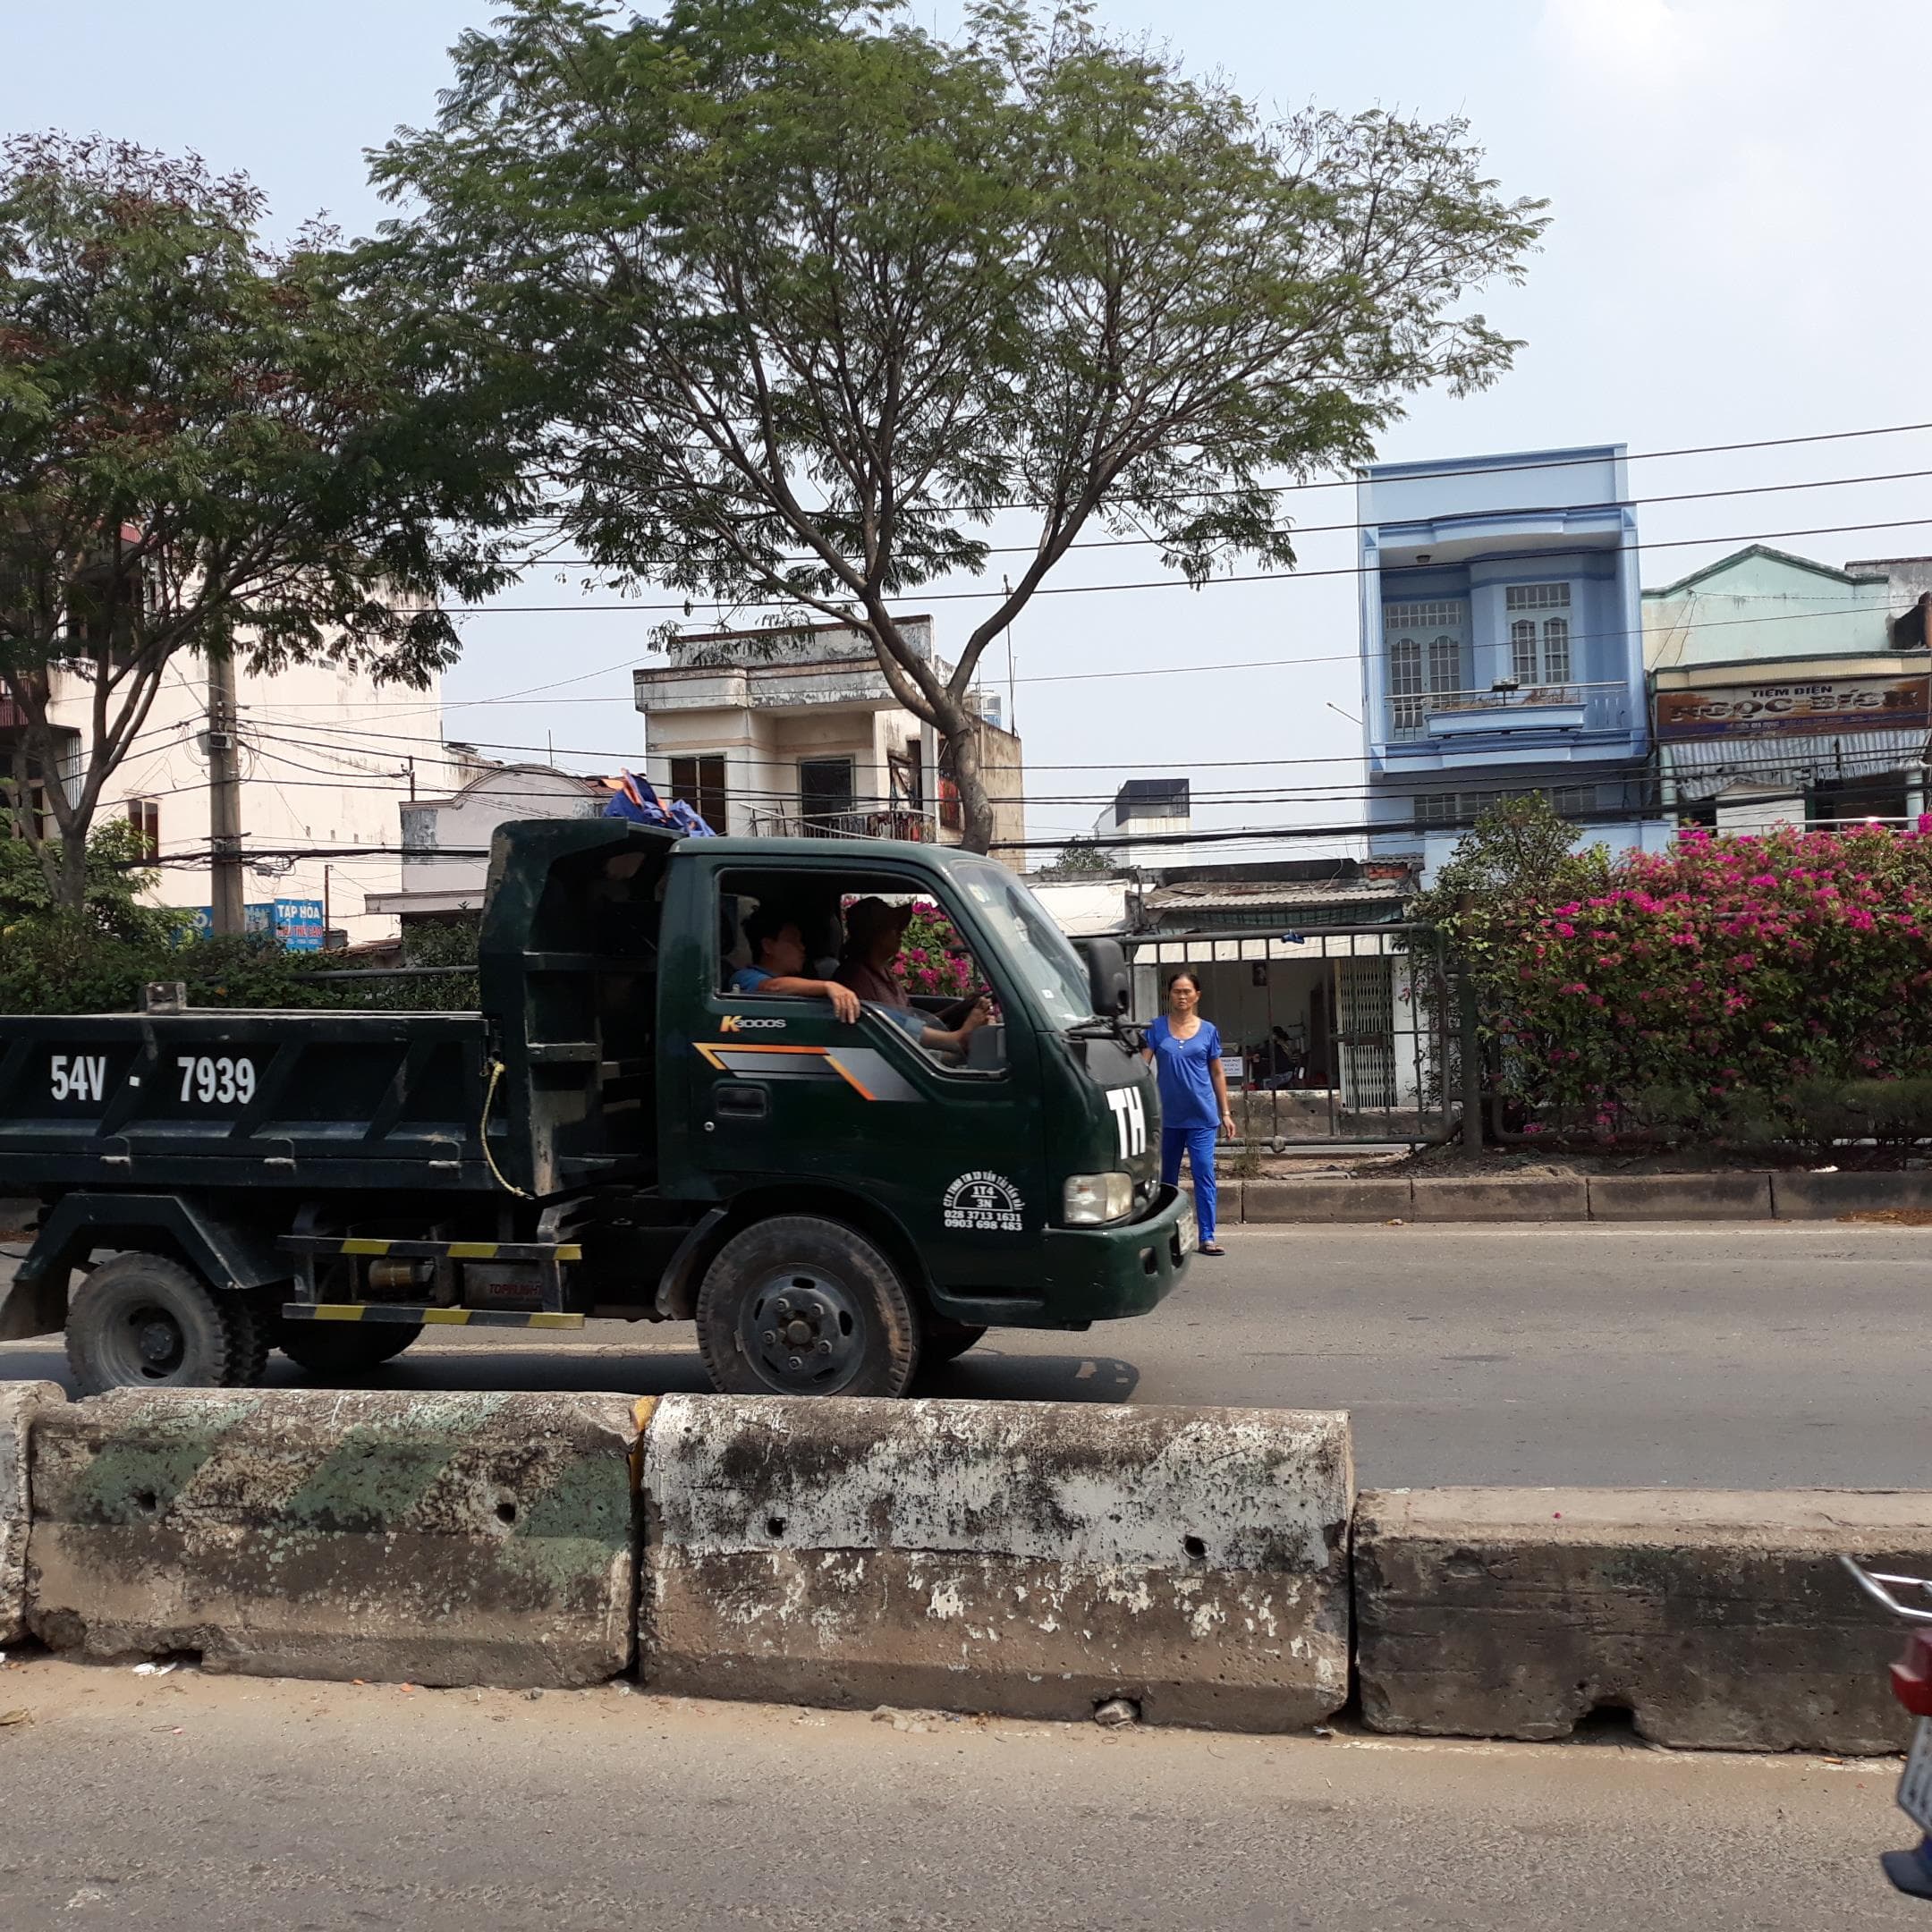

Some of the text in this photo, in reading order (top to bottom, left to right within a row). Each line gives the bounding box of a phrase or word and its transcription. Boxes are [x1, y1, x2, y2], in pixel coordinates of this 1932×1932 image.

[300, 903, 320, 919] HÓA
[720, 1015, 787, 1032] K3000S
[51, 1055, 256, 1104] 54V 7939
[1106, 1086, 1146, 1159] TH
[976, 1198, 993, 1208] 3N
[944, 1209, 1021, 1223] 028 3713 1631
[944, 1218, 974, 1229] 0903
[976, 1220, 998, 1230] 698
